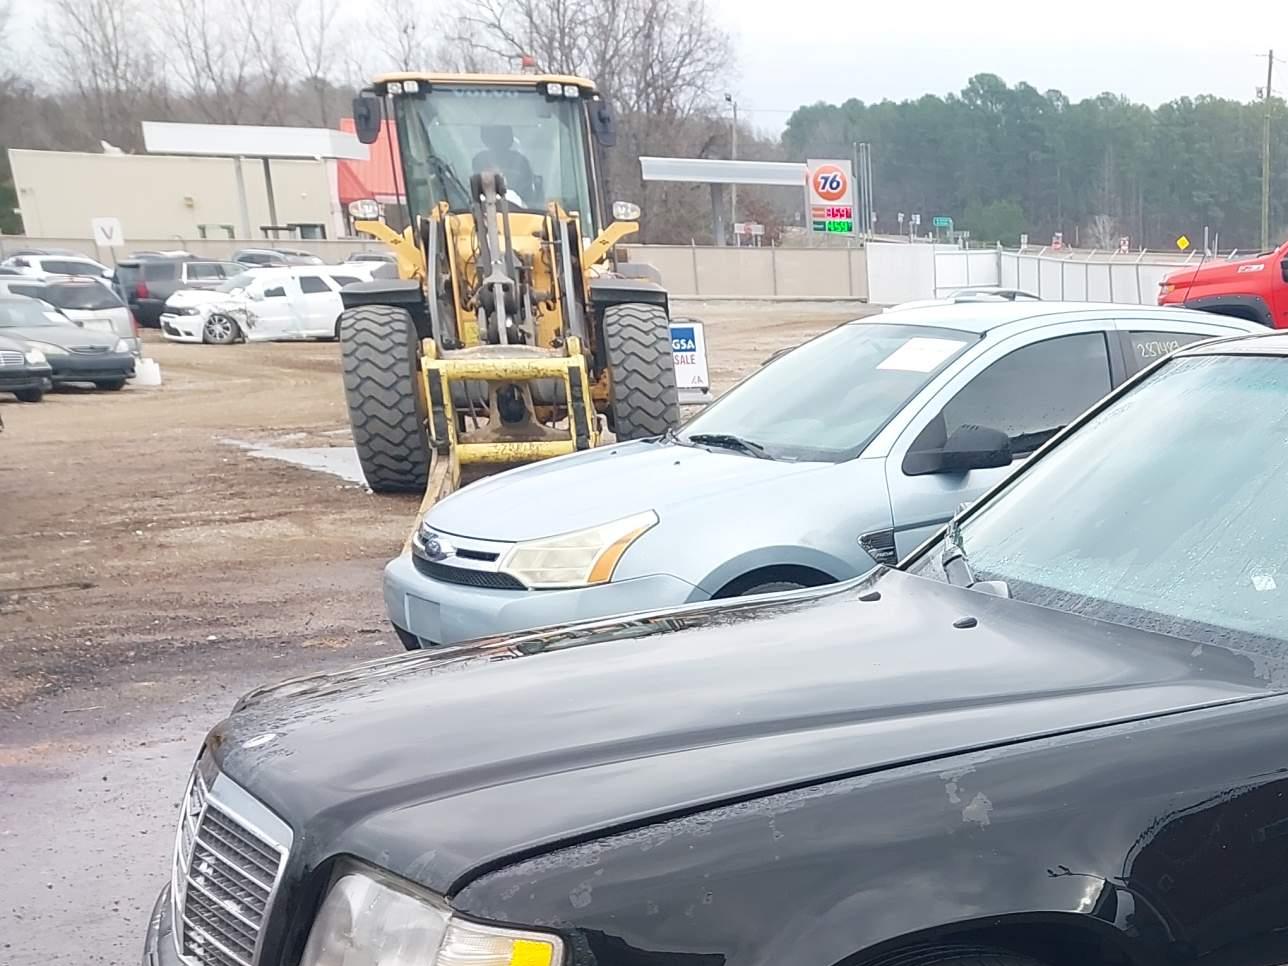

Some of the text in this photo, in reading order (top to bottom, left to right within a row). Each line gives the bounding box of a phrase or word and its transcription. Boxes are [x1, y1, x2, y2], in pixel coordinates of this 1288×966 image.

[820, 174, 841, 191] 76
[672, 339, 695, 350] GSA
[674, 354, 696, 365] SALE
